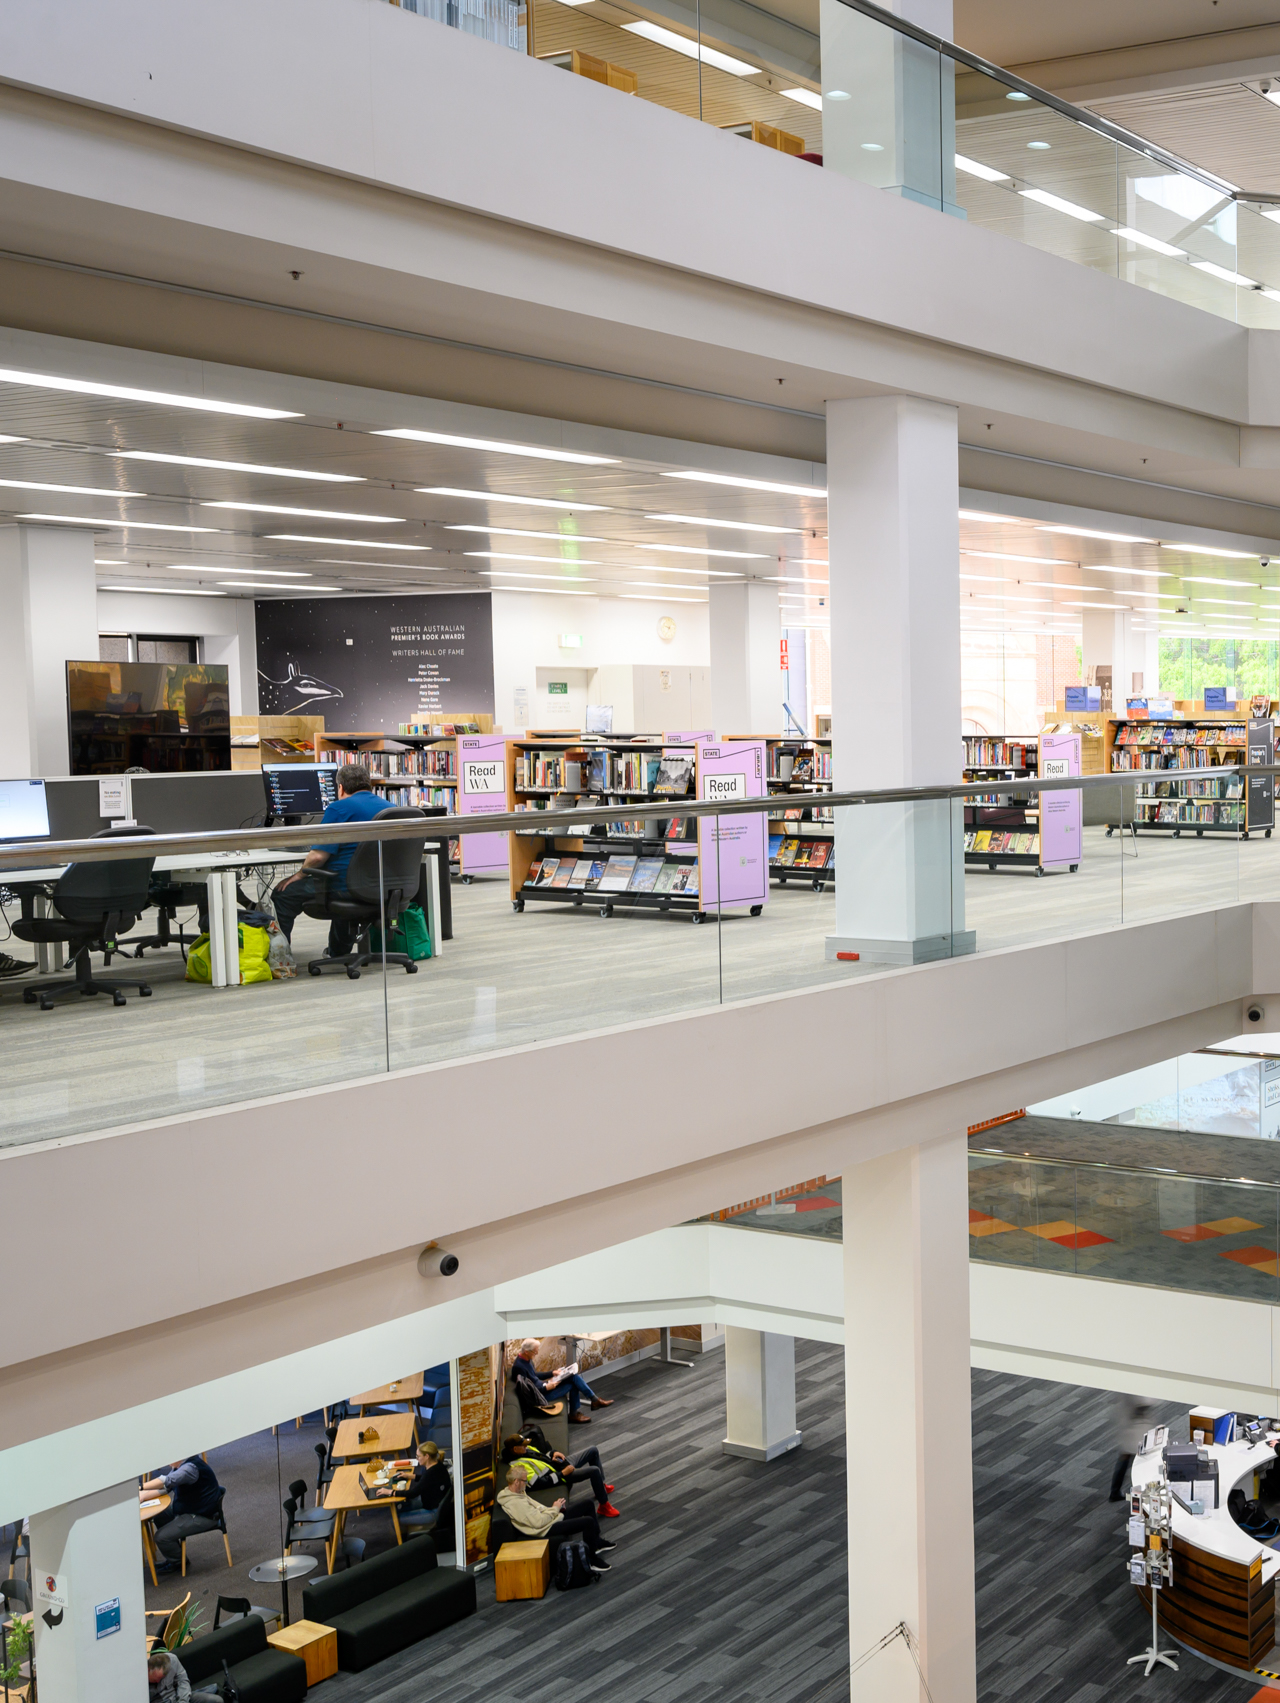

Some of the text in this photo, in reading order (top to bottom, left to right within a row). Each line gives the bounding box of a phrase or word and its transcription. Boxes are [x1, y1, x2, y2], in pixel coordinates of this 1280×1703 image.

[469, 765, 496, 776] Read
[1047, 763, 1064, 773] Read
[469, 778, 489, 789] WA
[709, 778, 736, 792] Read
